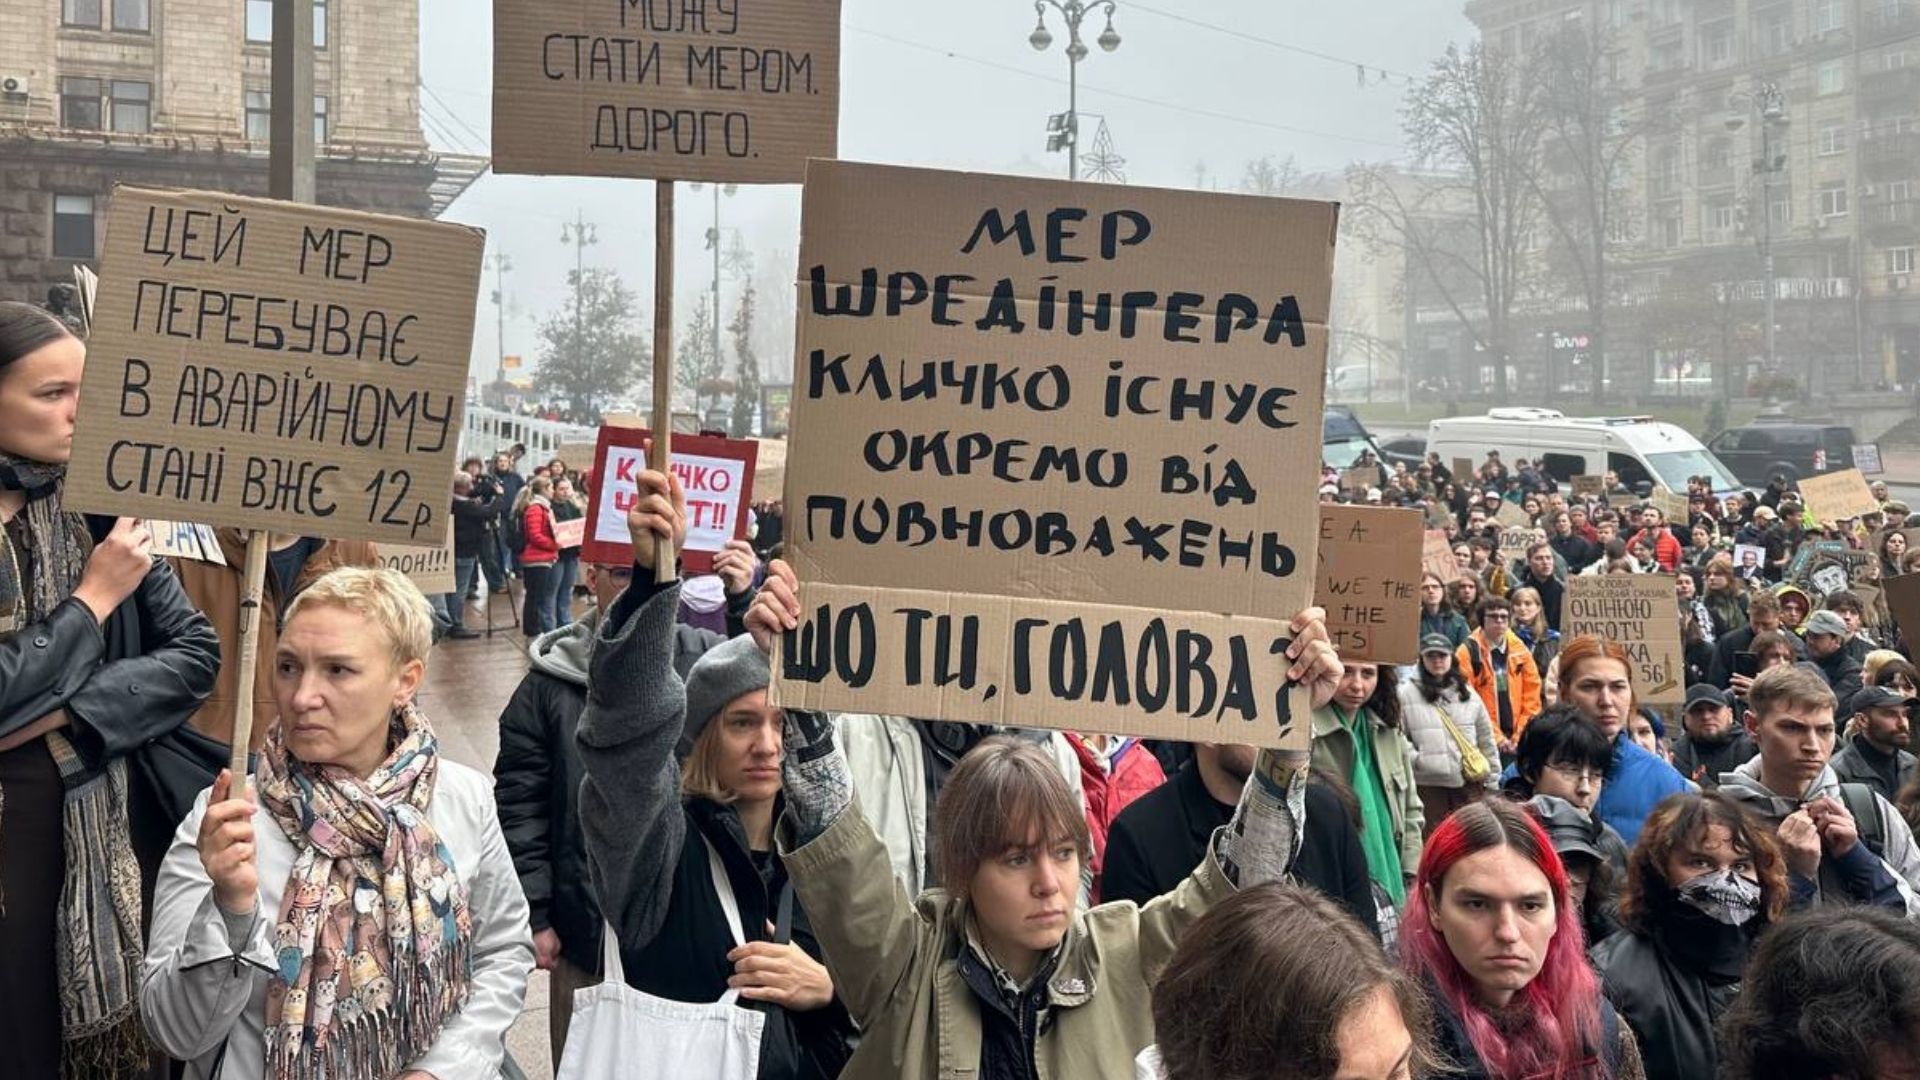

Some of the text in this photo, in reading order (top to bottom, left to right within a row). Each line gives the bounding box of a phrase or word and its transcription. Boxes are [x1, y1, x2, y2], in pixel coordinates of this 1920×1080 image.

[619, 0, 738, 34] МОЖУ
[542, 34, 820, 95] СТАТИ МЕРОМ.
[590, 105, 759, 158] ДОРОГО.
[142, 205, 393, 284] ЦЕЙ МЕР
[960, 207, 1153, 264] МЕР
[133, 279, 419, 367] ПЕРЕБУВАЄ
[120, 358, 455, 455] В АВАРІЙНОМУ
[808, 348, 1071, 412] КЛИЧКО
[105, 439, 225, 504] СТАНІ
[615, 456, 731, 493] КЧКО
[863, 428, 1129, 488] ОКРЕМО
[614, 490, 728, 531] ЧТ!!
[806, 495, 1297, 577] ПОВНОВАЖЕНЬ
[1328, 576, 1414, 599] WE THE
[1341, 603, 1386, 624] THE
[1570, 599, 1652, 619] ОЦІНЮЮ
[783, 602, 877, 688] ШО
[893, 607, 998, 702] ТИ,
